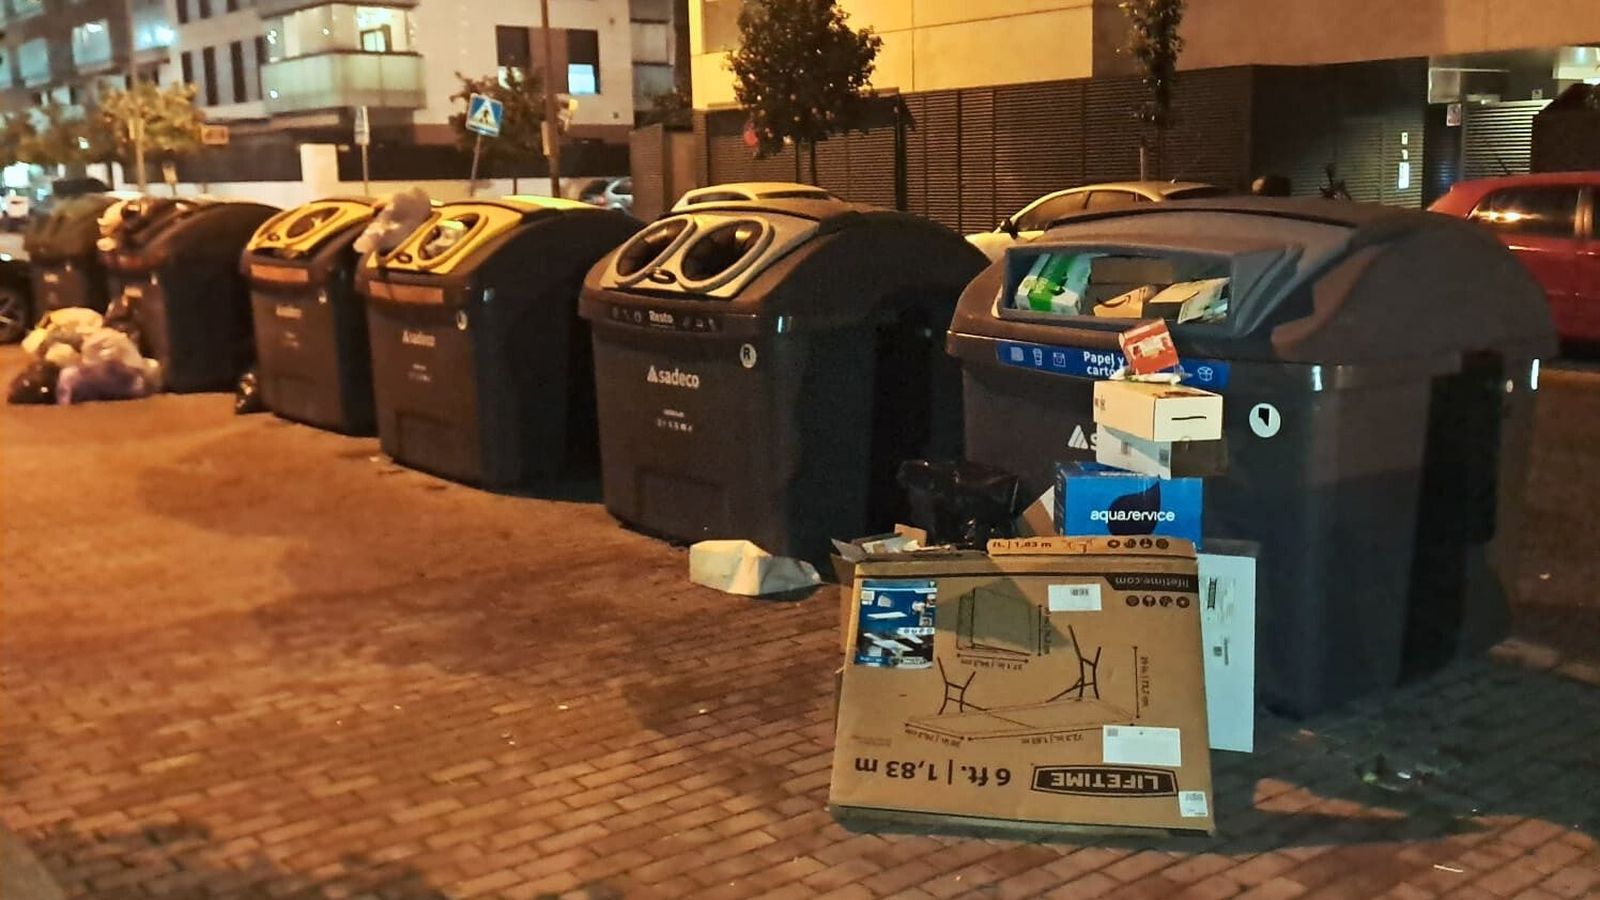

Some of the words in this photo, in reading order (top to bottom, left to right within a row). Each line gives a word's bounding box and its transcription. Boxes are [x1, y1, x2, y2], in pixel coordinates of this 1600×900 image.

[649, 310, 673, 324] Resto
[1083, 351, 1115, 368] Papel
[1117, 356, 1125, 369] y
[659, 368, 700, 388] sadeco
[1090, 510, 1176, 524] aquaservice
[1115, 576, 1189, 588] lifetime.com
[855, 757, 878, 773] m
[886, 760, 938, 782] 1,83
[961, 766, 989, 787] ft.
[995, 768, 1011, 786] 6
[1051, 772, 1158, 790] LIFETIME
